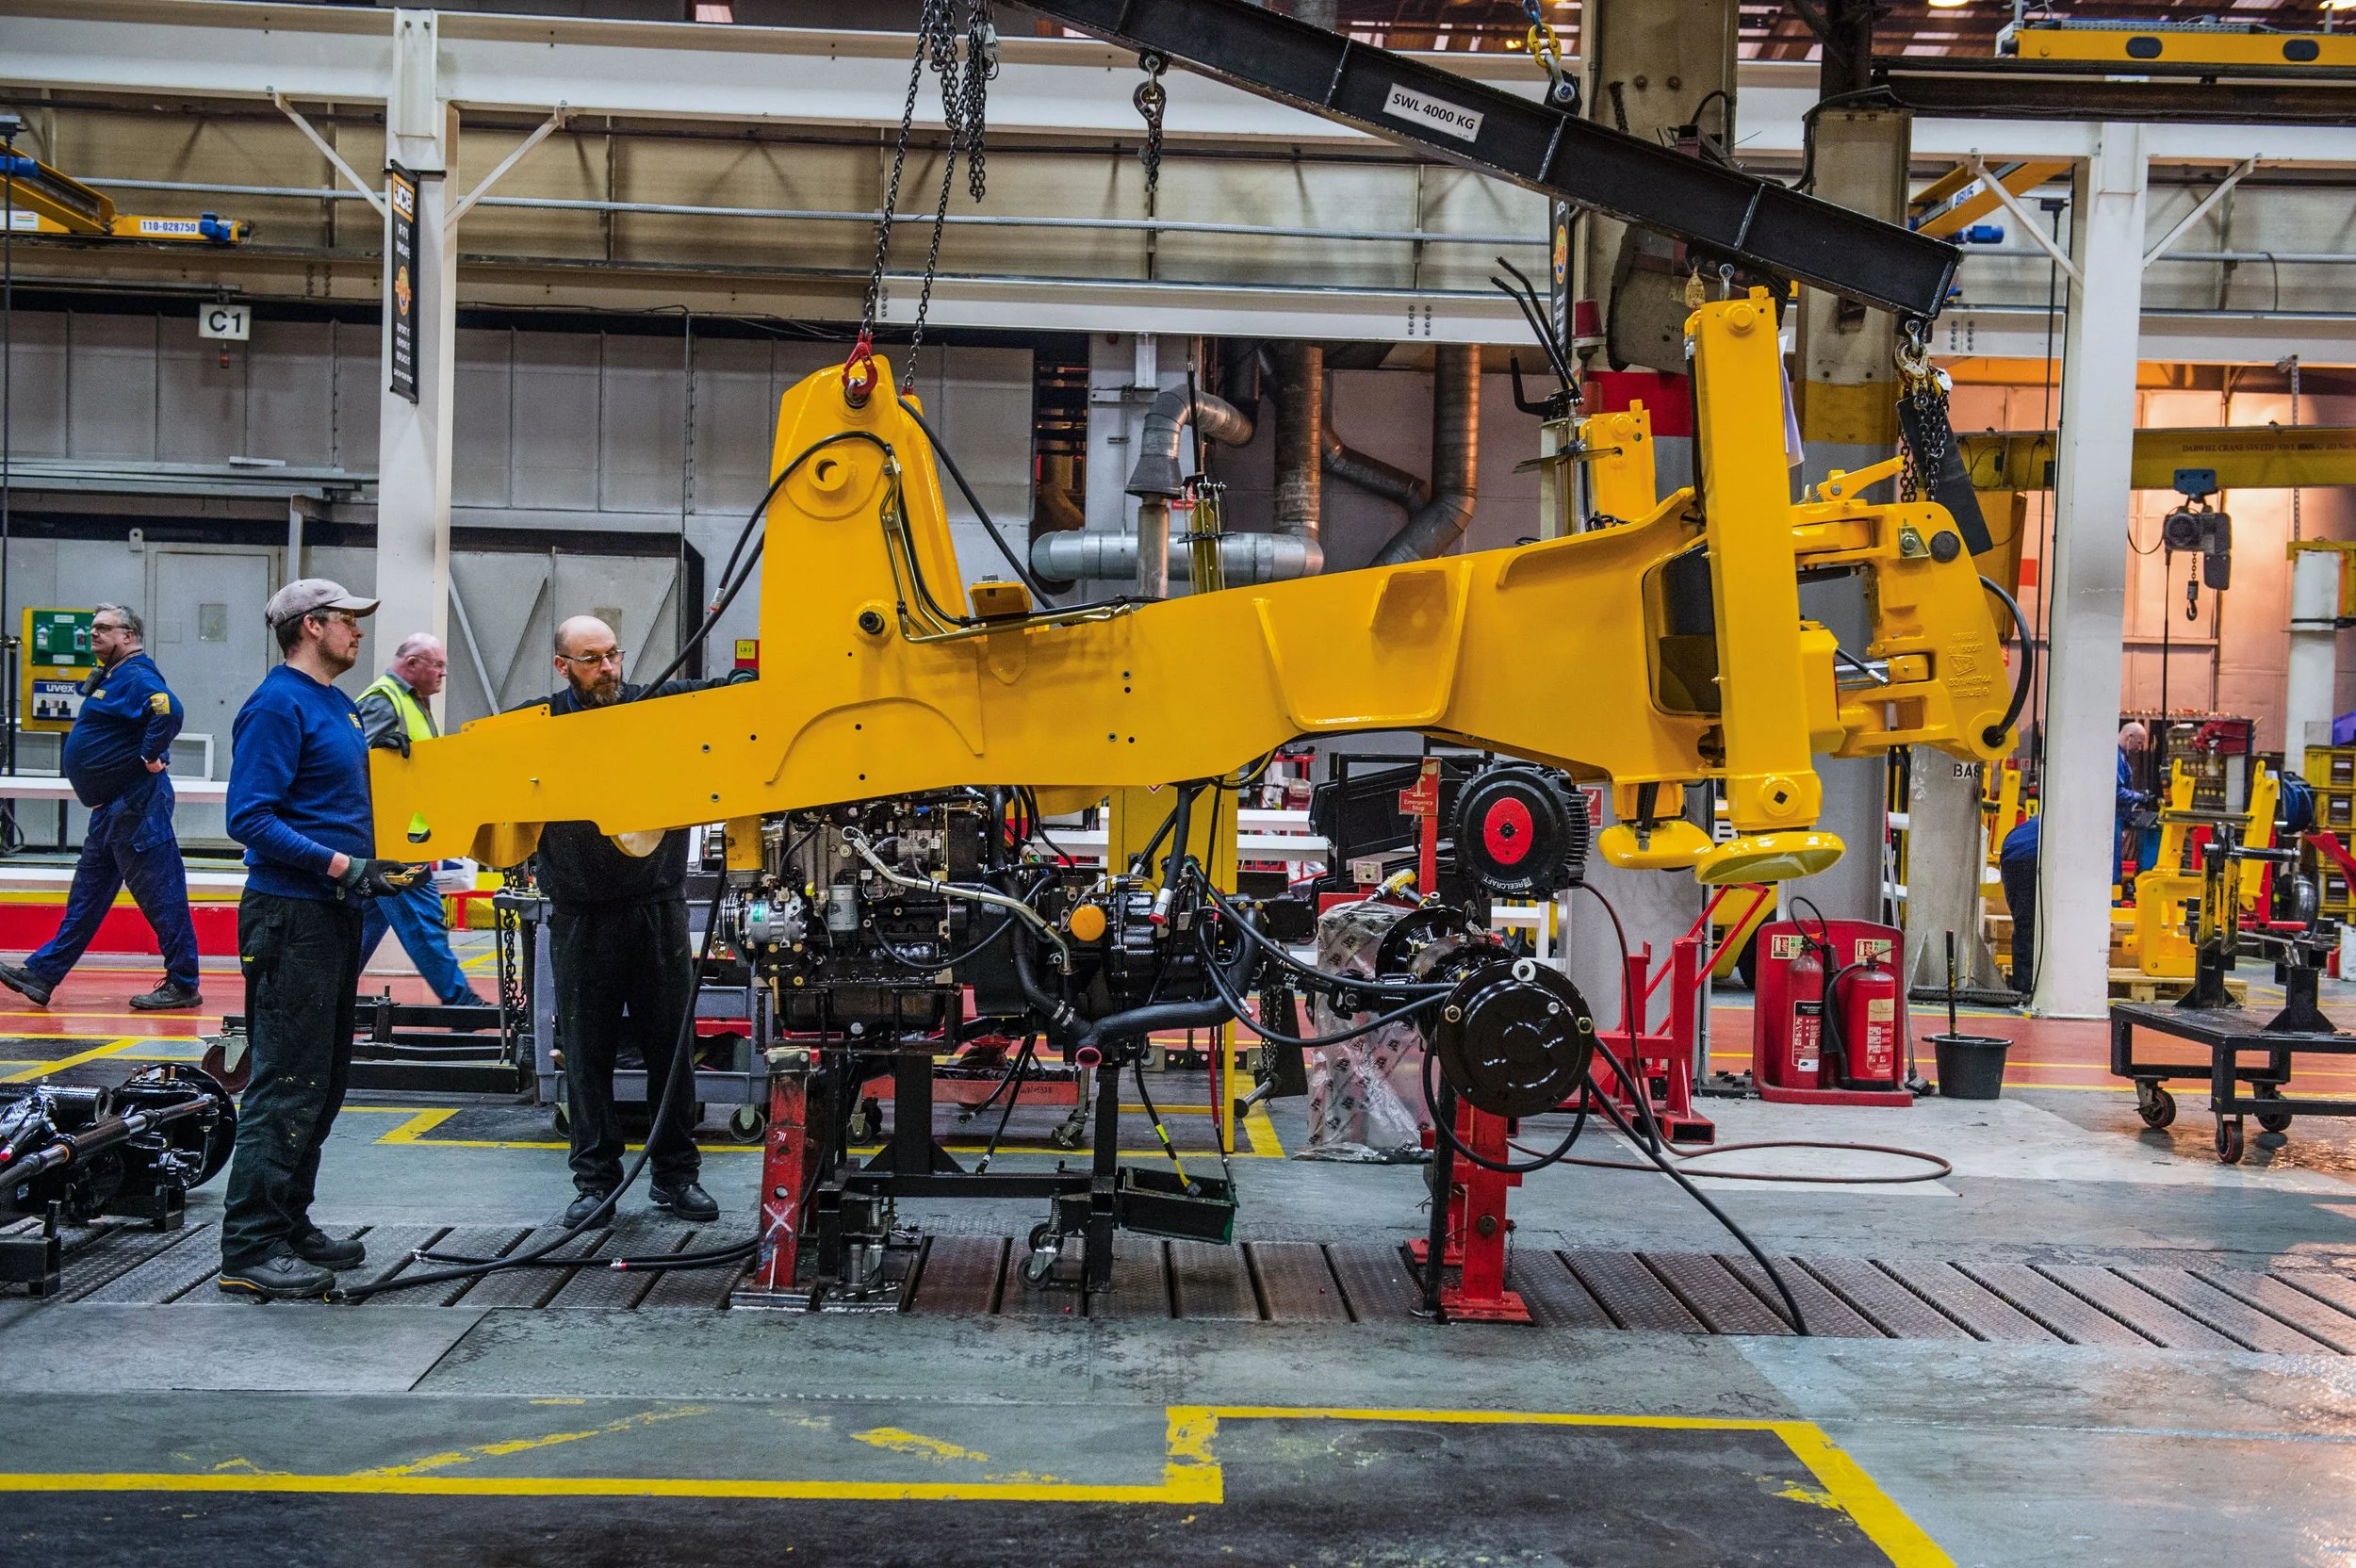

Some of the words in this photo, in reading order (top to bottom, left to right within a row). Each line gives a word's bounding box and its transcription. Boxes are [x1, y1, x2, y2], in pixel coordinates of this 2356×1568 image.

[1393, 93, 1419, 111] SWL
[1423, 104, 1454, 122] 4000
[1456, 115, 1476, 130] KG
[394, 183, 413, 216] JCB
[142, 220, 196, 233] 110-028750
[208, 310, 241, 334] C1
[46, 683, 74, 694] uvex
[1483, 875, 1524, 890] REELCRAFT
